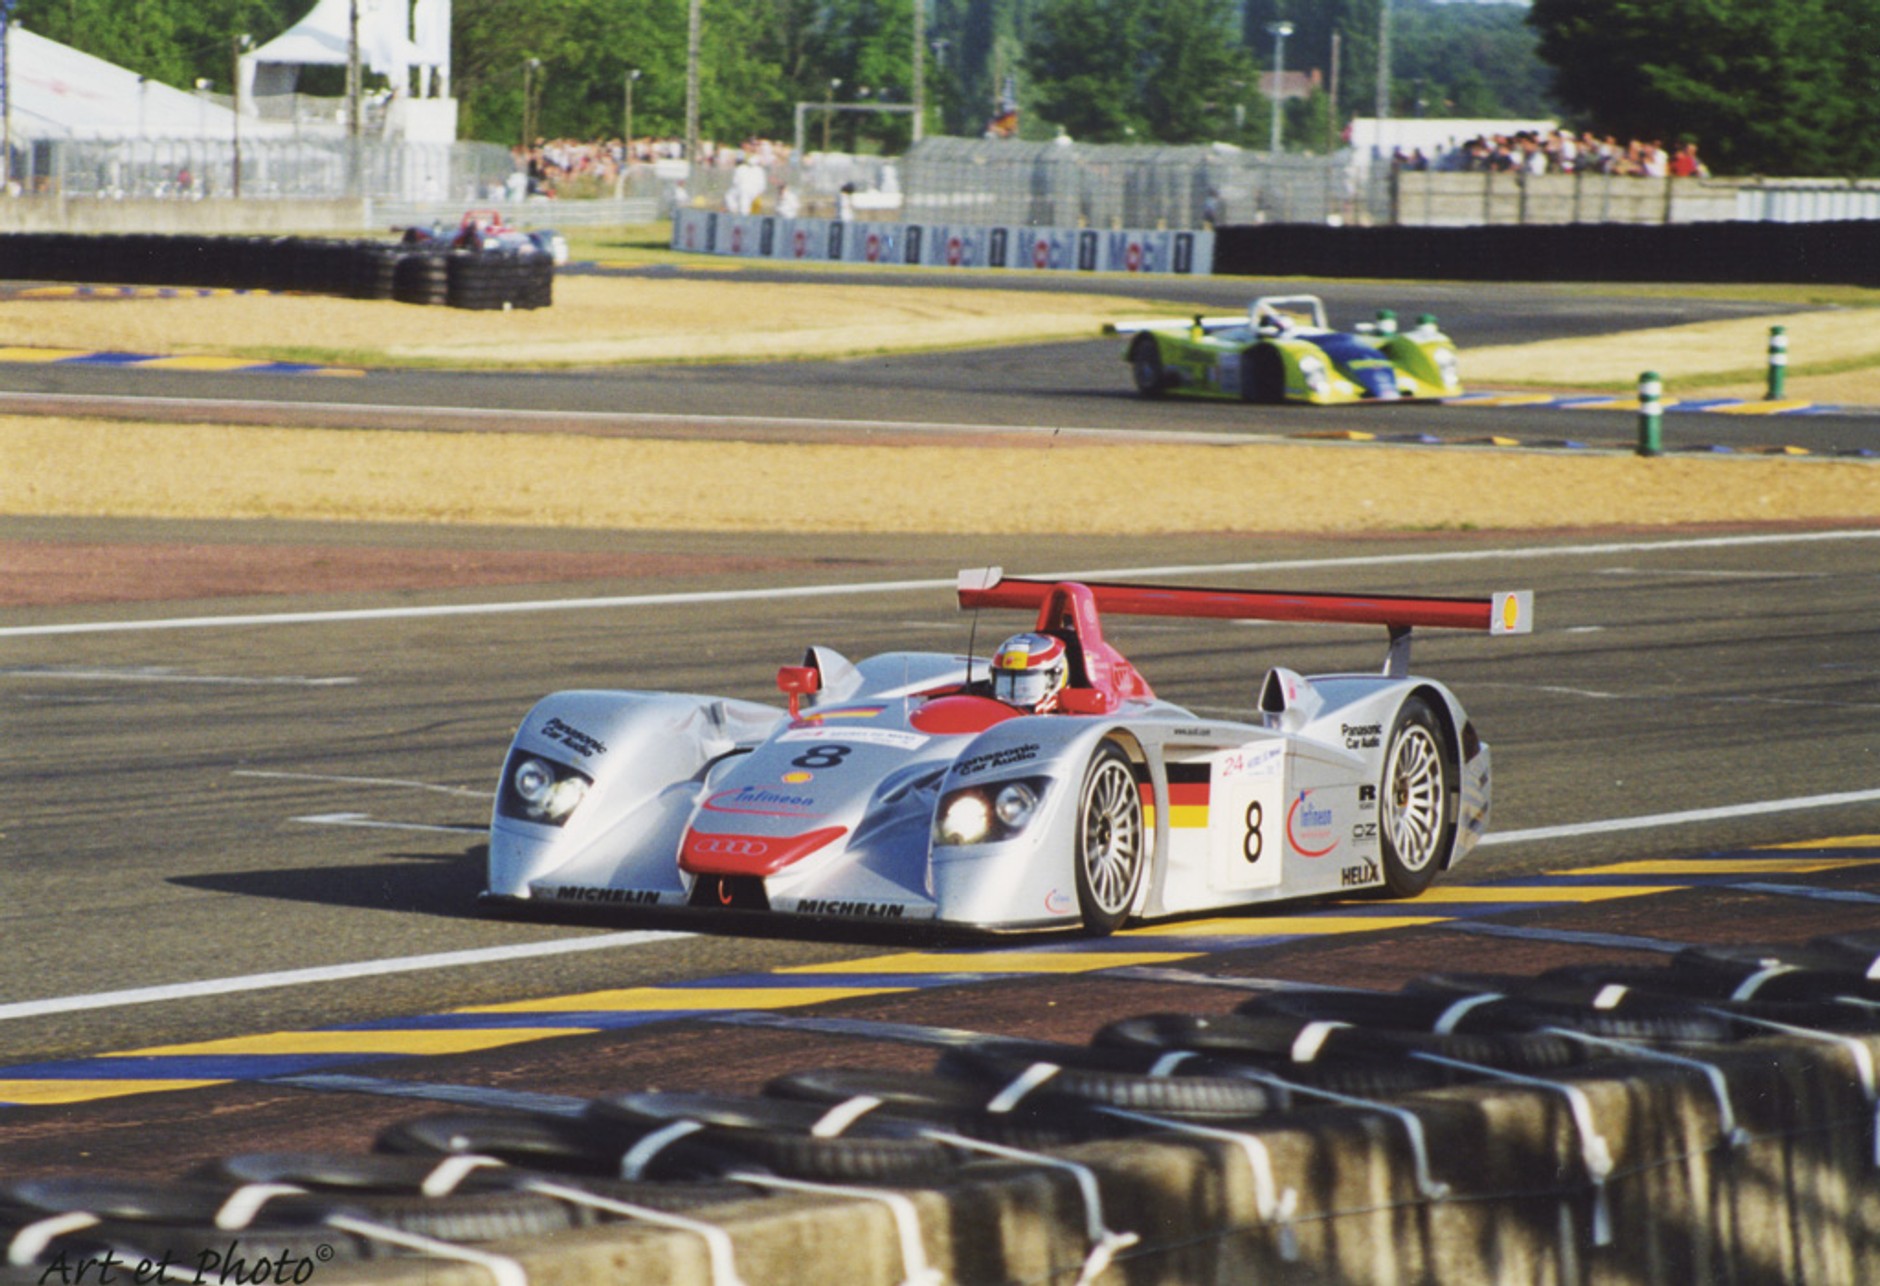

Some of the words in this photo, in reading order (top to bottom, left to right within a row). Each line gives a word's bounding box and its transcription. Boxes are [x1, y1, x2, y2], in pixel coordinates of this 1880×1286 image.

[546, 717, 607, 754] Panasonic
[791, 744, 853, 769] 8
[952, 743, 1040, 773] Panasonic
[960, 763, 987, 776] Car
[992, 752, 1037, 768] Audio
[1222, 753, 1244, 777] 24
[1243, 799, 1263, 864] 8
[1341, 861, 1379, 887] HELIX
[557, 885, 661, 904] MICHELIN
[797, 898, 905, 917] MICHELIN
